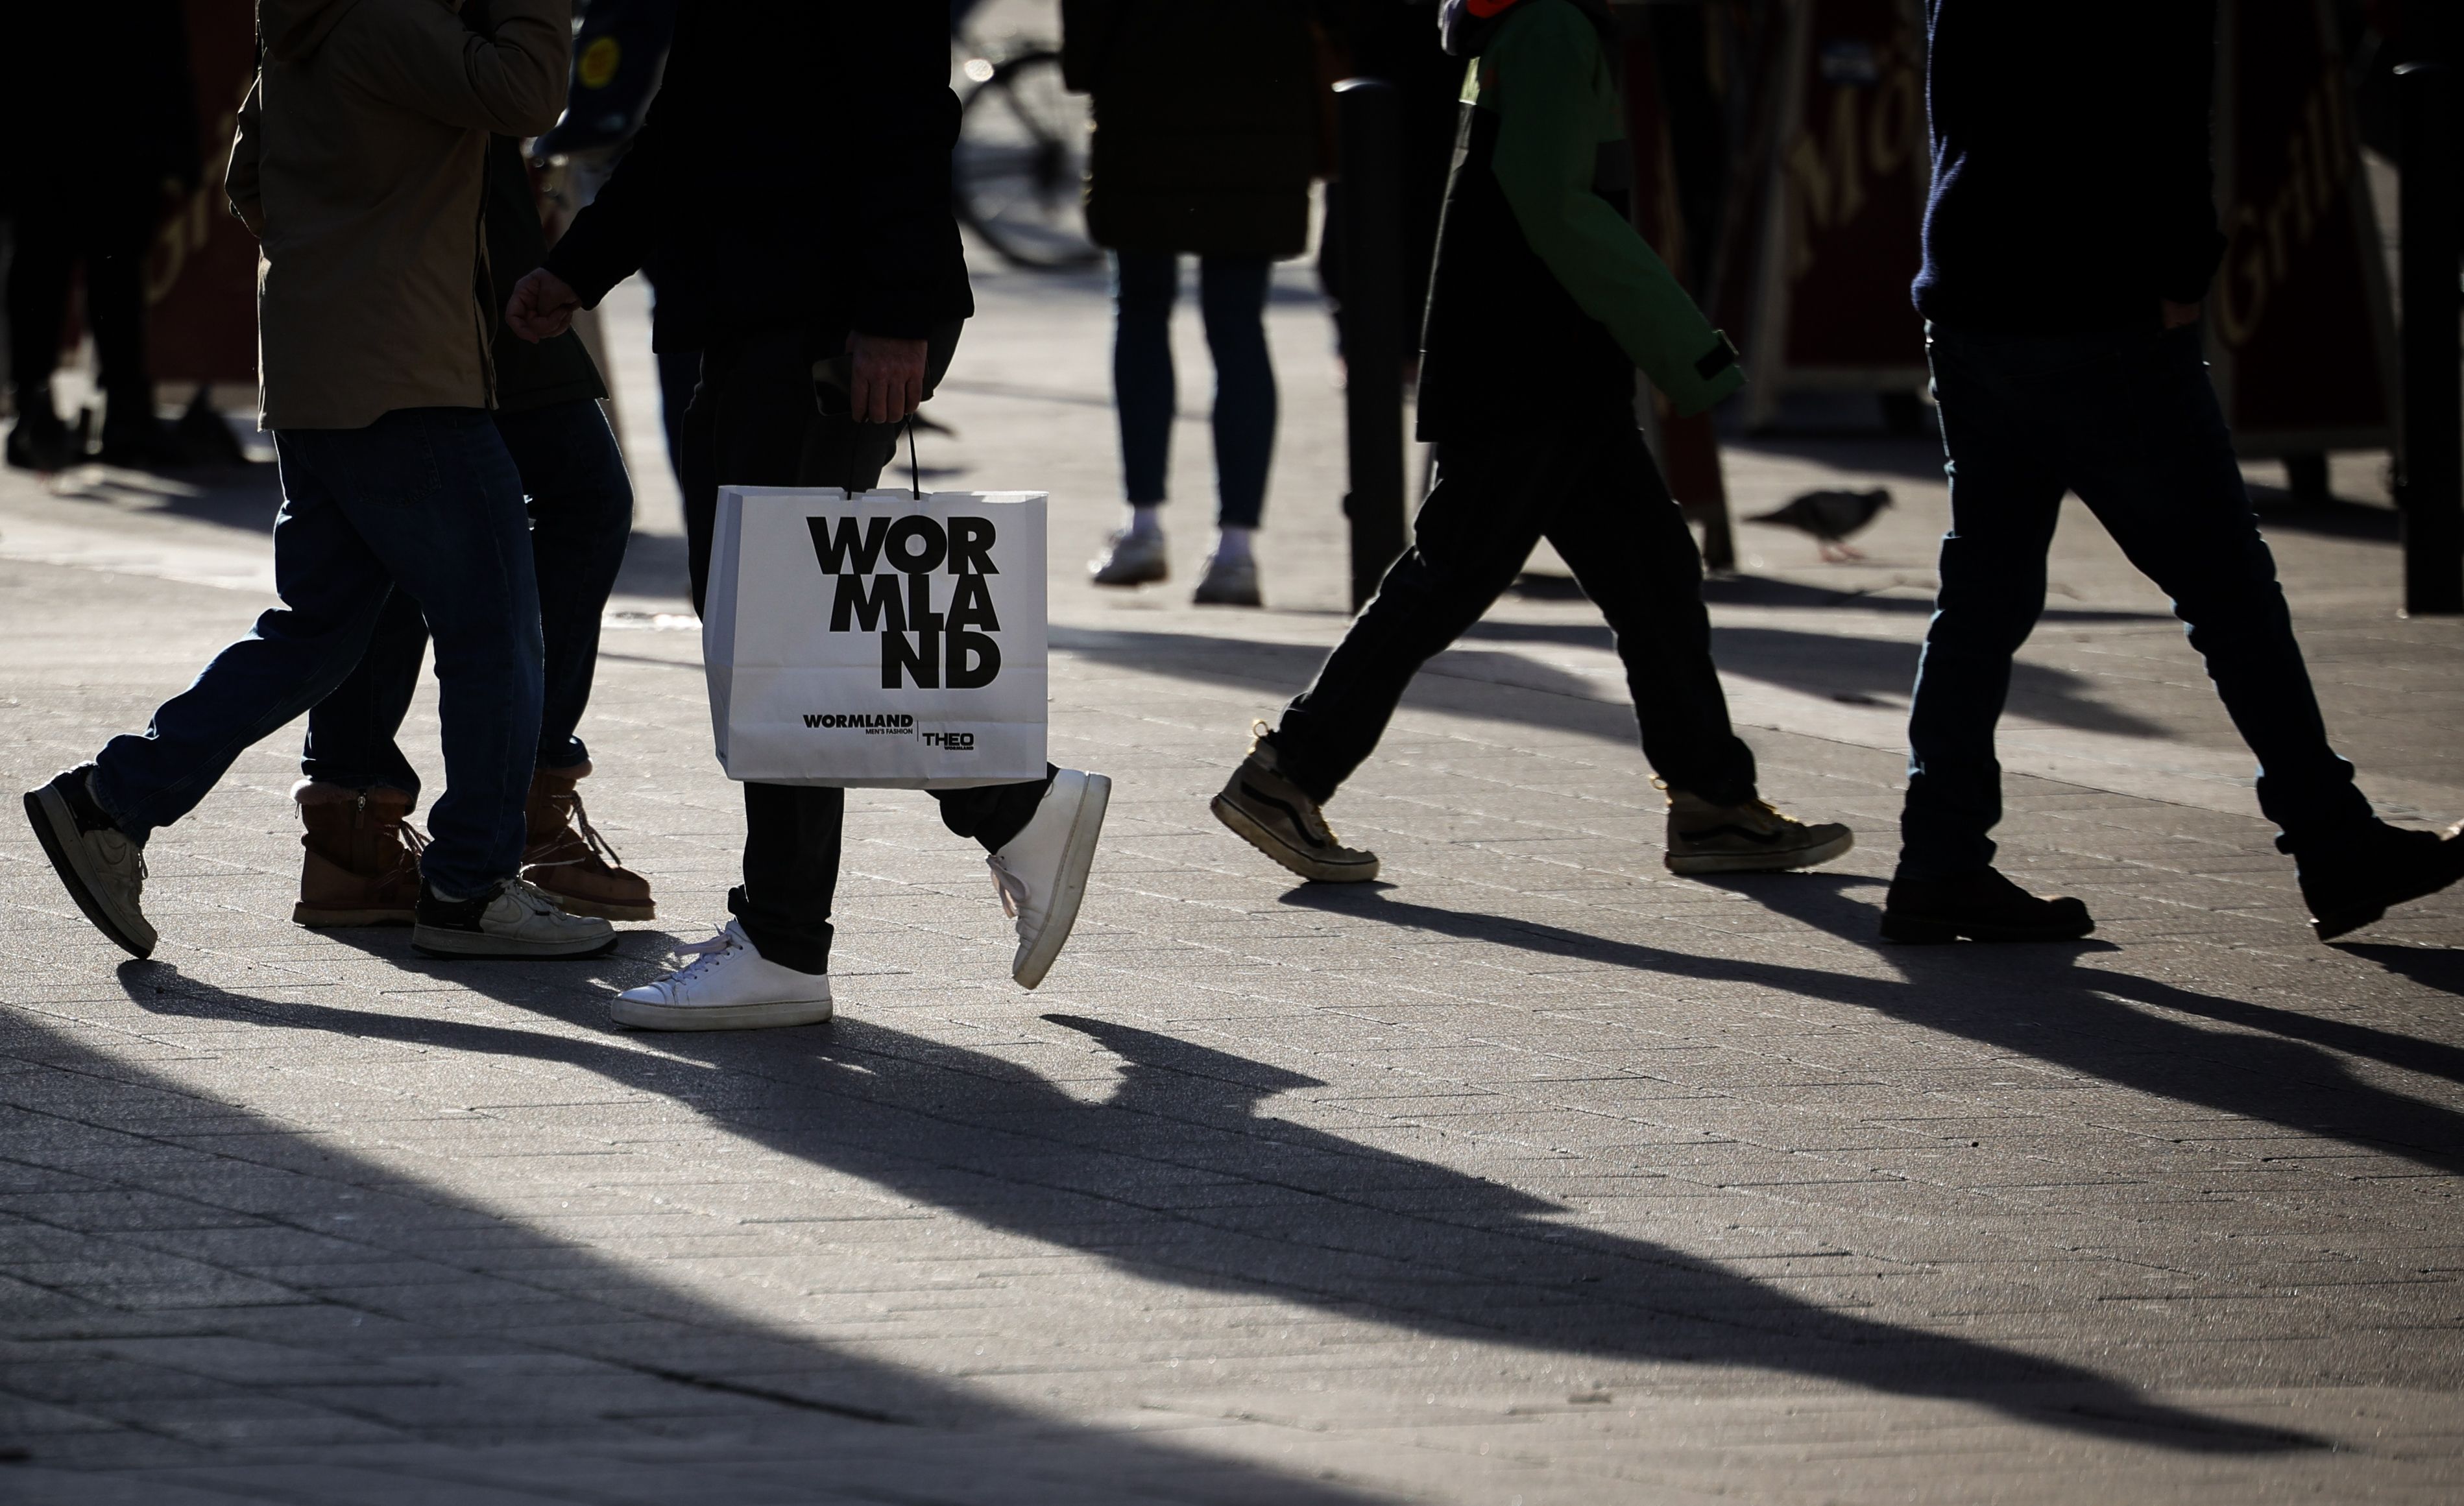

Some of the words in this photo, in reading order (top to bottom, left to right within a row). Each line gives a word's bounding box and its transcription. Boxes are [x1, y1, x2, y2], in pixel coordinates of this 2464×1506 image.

[806, 515, 1000, 574] WOR
[829, 574, 1000, 631] MLA
[881, 631, 1001, 689] ND
[803, 715, 913, 728] WORMLAND
[922, 733, 974, 746] THEO
